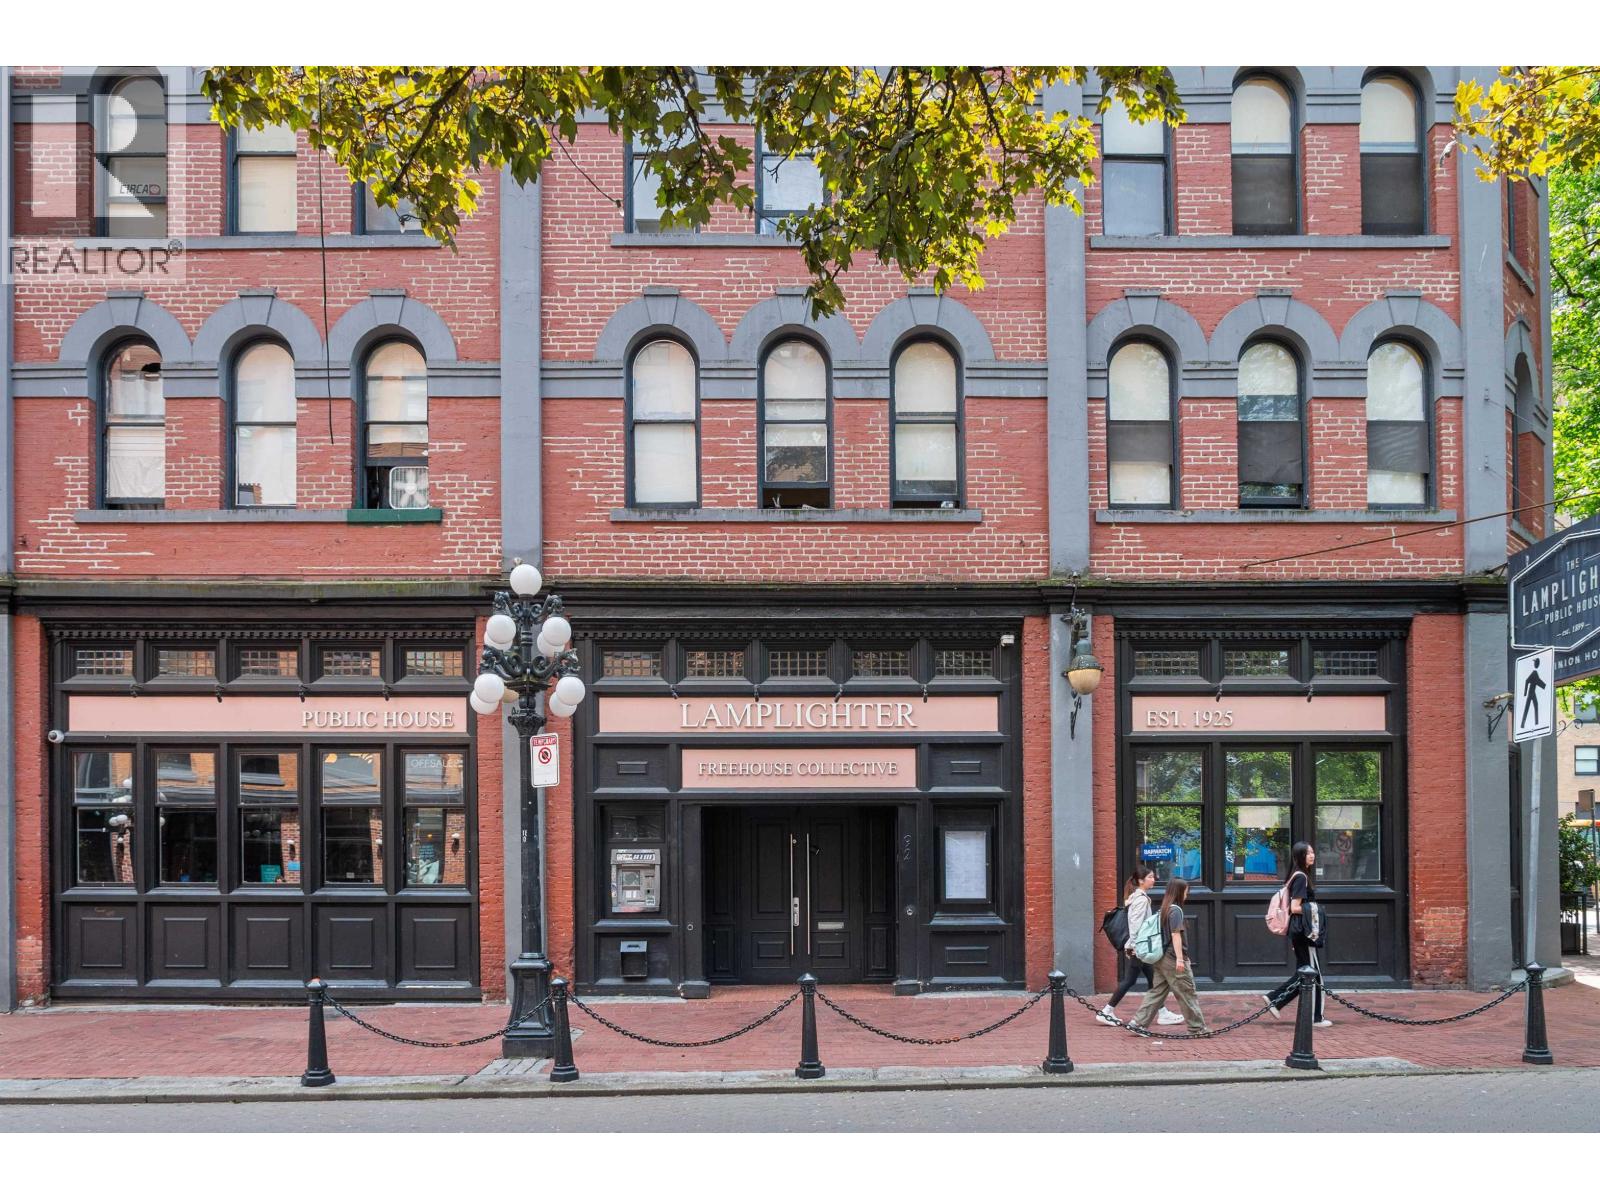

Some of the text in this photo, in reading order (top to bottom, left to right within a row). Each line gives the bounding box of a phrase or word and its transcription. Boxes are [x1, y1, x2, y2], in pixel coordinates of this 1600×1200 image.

[1566, 557, 1580, 572] THE
[1544, 604, 1573, 625] PUBLIC
[1554, 648, 1600, 671] INION HO
[302, 710, 454, 728] PUBLIC HOUSE
[680, 702, 918, 728] LAMPLIGHTER
[1146, 710, 1234, 728] EST. 1925
[698, 761, 898, 776] FREEHOUSE COLLECTIVE
